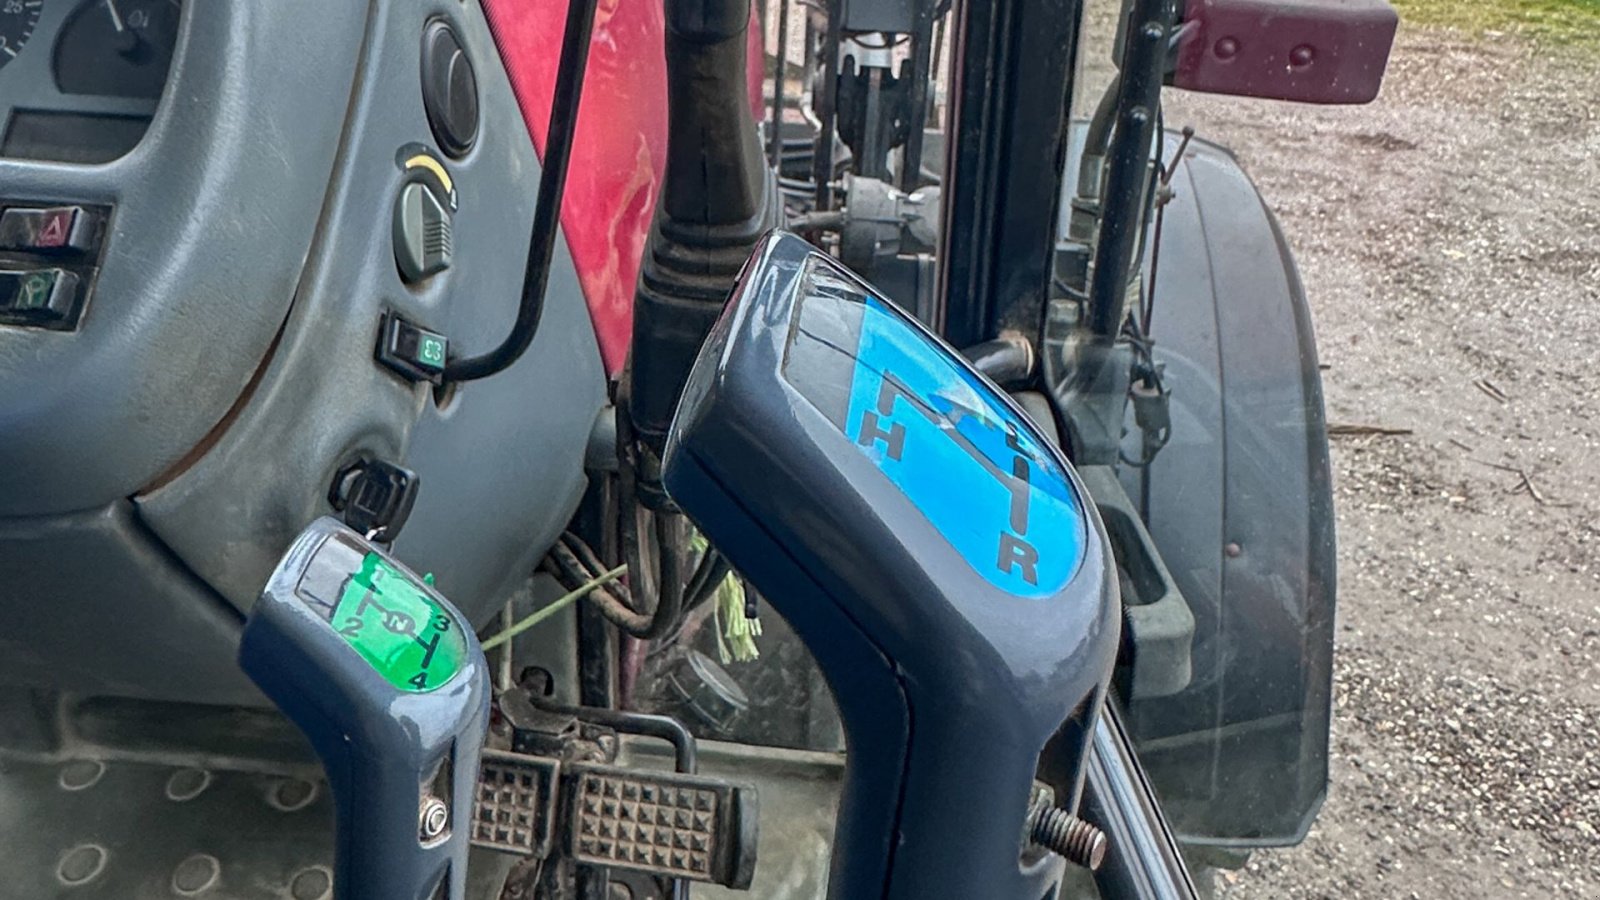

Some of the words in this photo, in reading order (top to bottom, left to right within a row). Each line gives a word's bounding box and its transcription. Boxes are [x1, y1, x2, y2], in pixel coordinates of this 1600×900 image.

[857, 410, 906, 463] H
[997, 531, 1039, 586] R
[342, 617, 364, 638] 2
[390, 616, 409, 632] N
[433, 614, 451, 632] 3
[408, 671, 428, 690] 4
